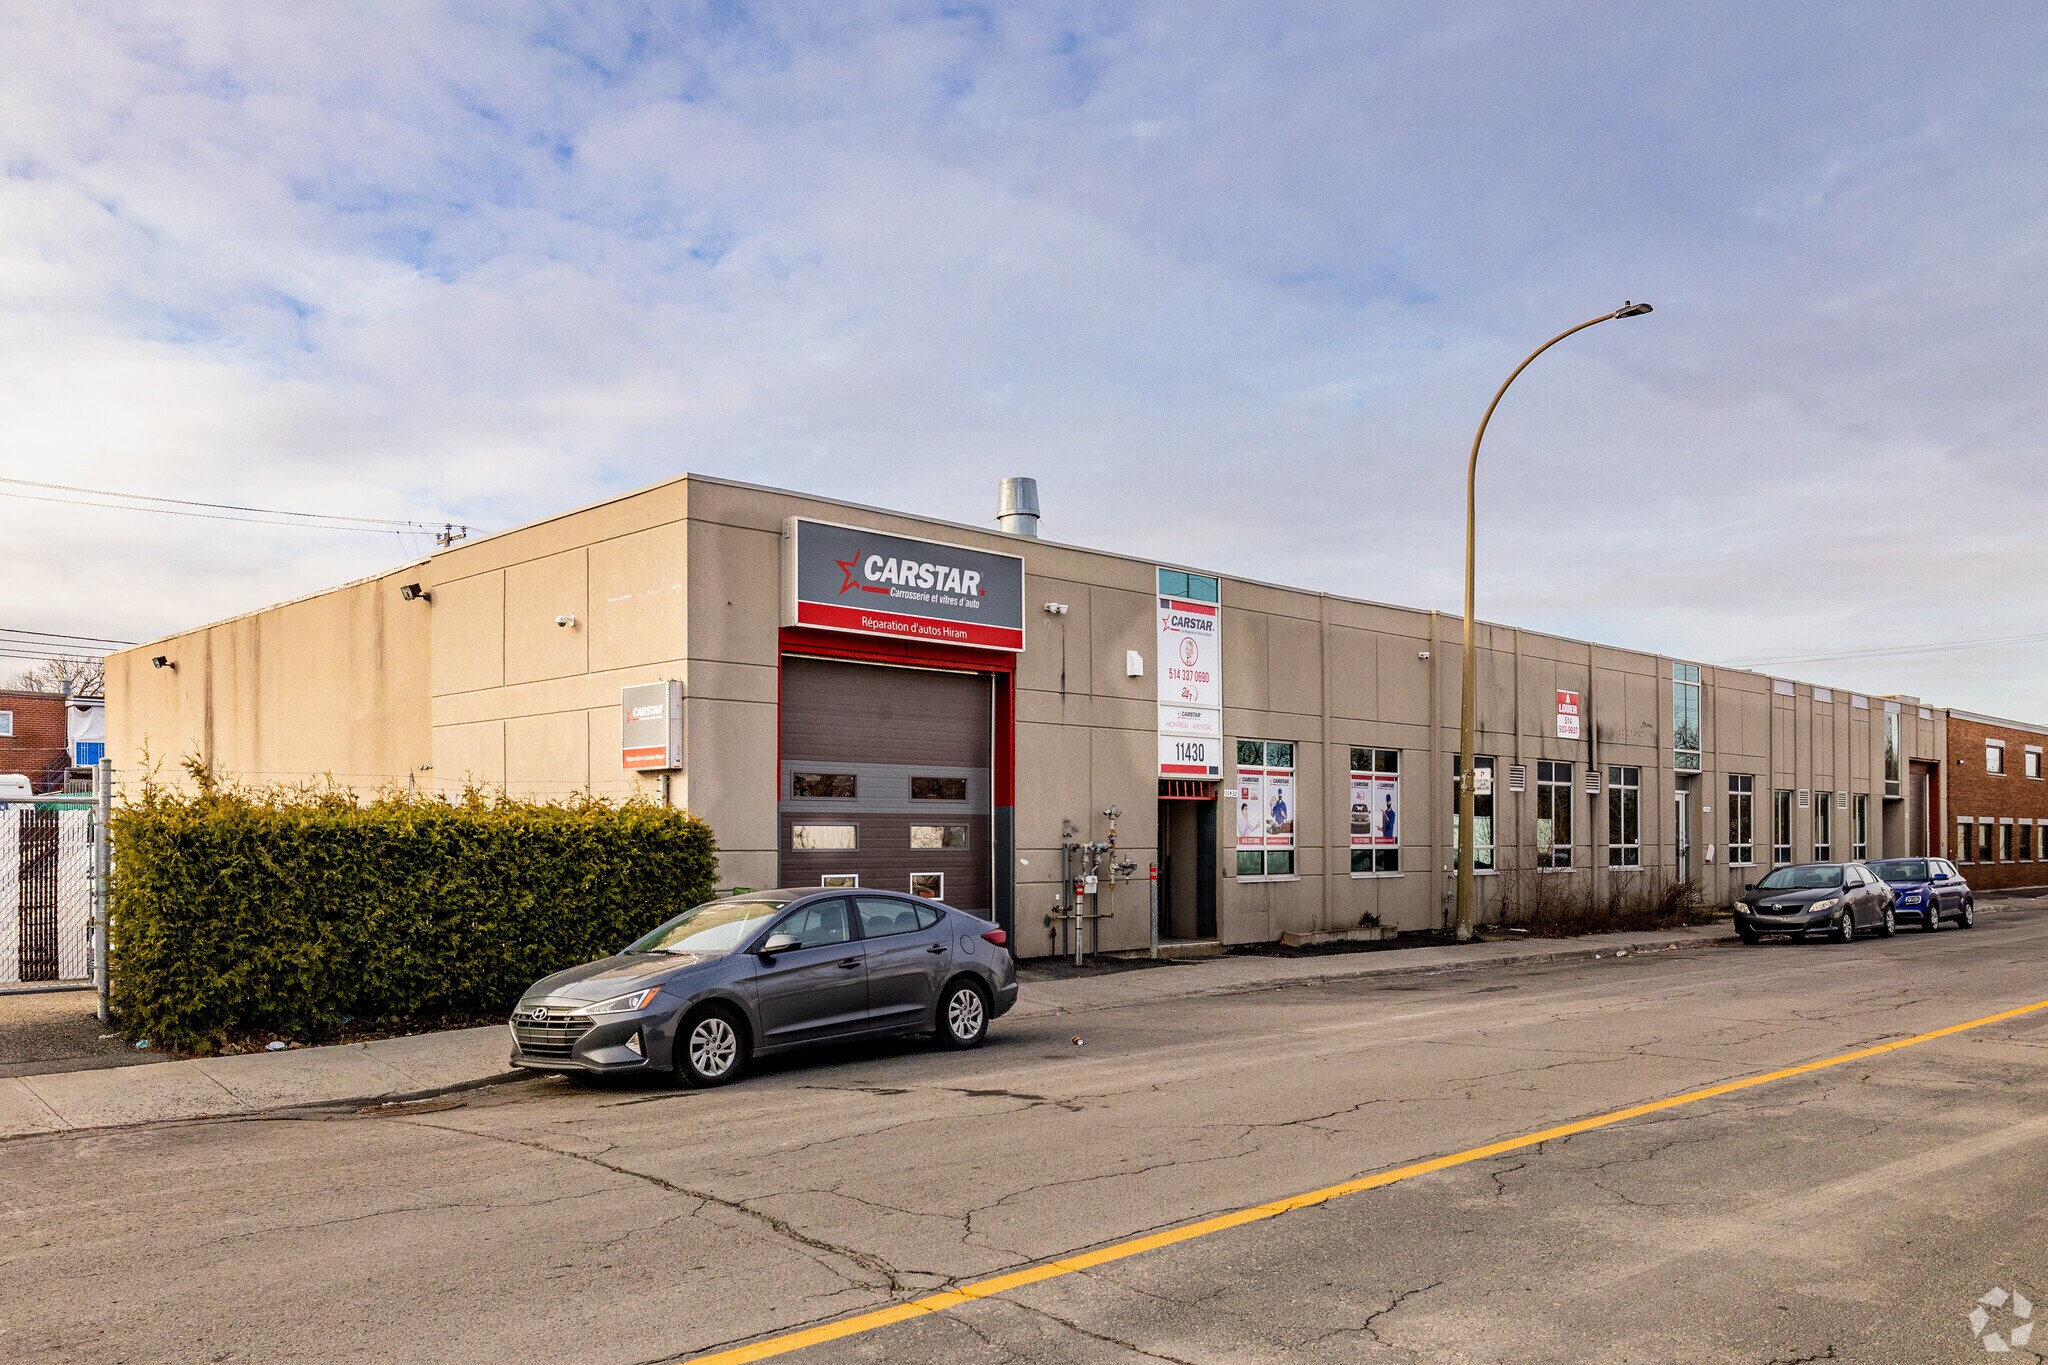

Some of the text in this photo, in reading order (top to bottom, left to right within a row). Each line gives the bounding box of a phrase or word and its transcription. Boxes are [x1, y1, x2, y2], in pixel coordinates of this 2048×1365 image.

[864, 554, 981, 596] CARSTAR
[890, 587, 980, 609] Carrosserie et vitres d'auto
[862, 616, 968, 639] Réparation d'autos Hiram
[1171, 615, 1213, 632] CARSTAR
[1168, 668, 1181, 680] 514
[1182, 669, 1193, 681] 337
[632, 704, 663, 717] CARSTAR
[1558, 703, 1578, 715] LOUER
[1175, 742, 1205, 762] 11430
